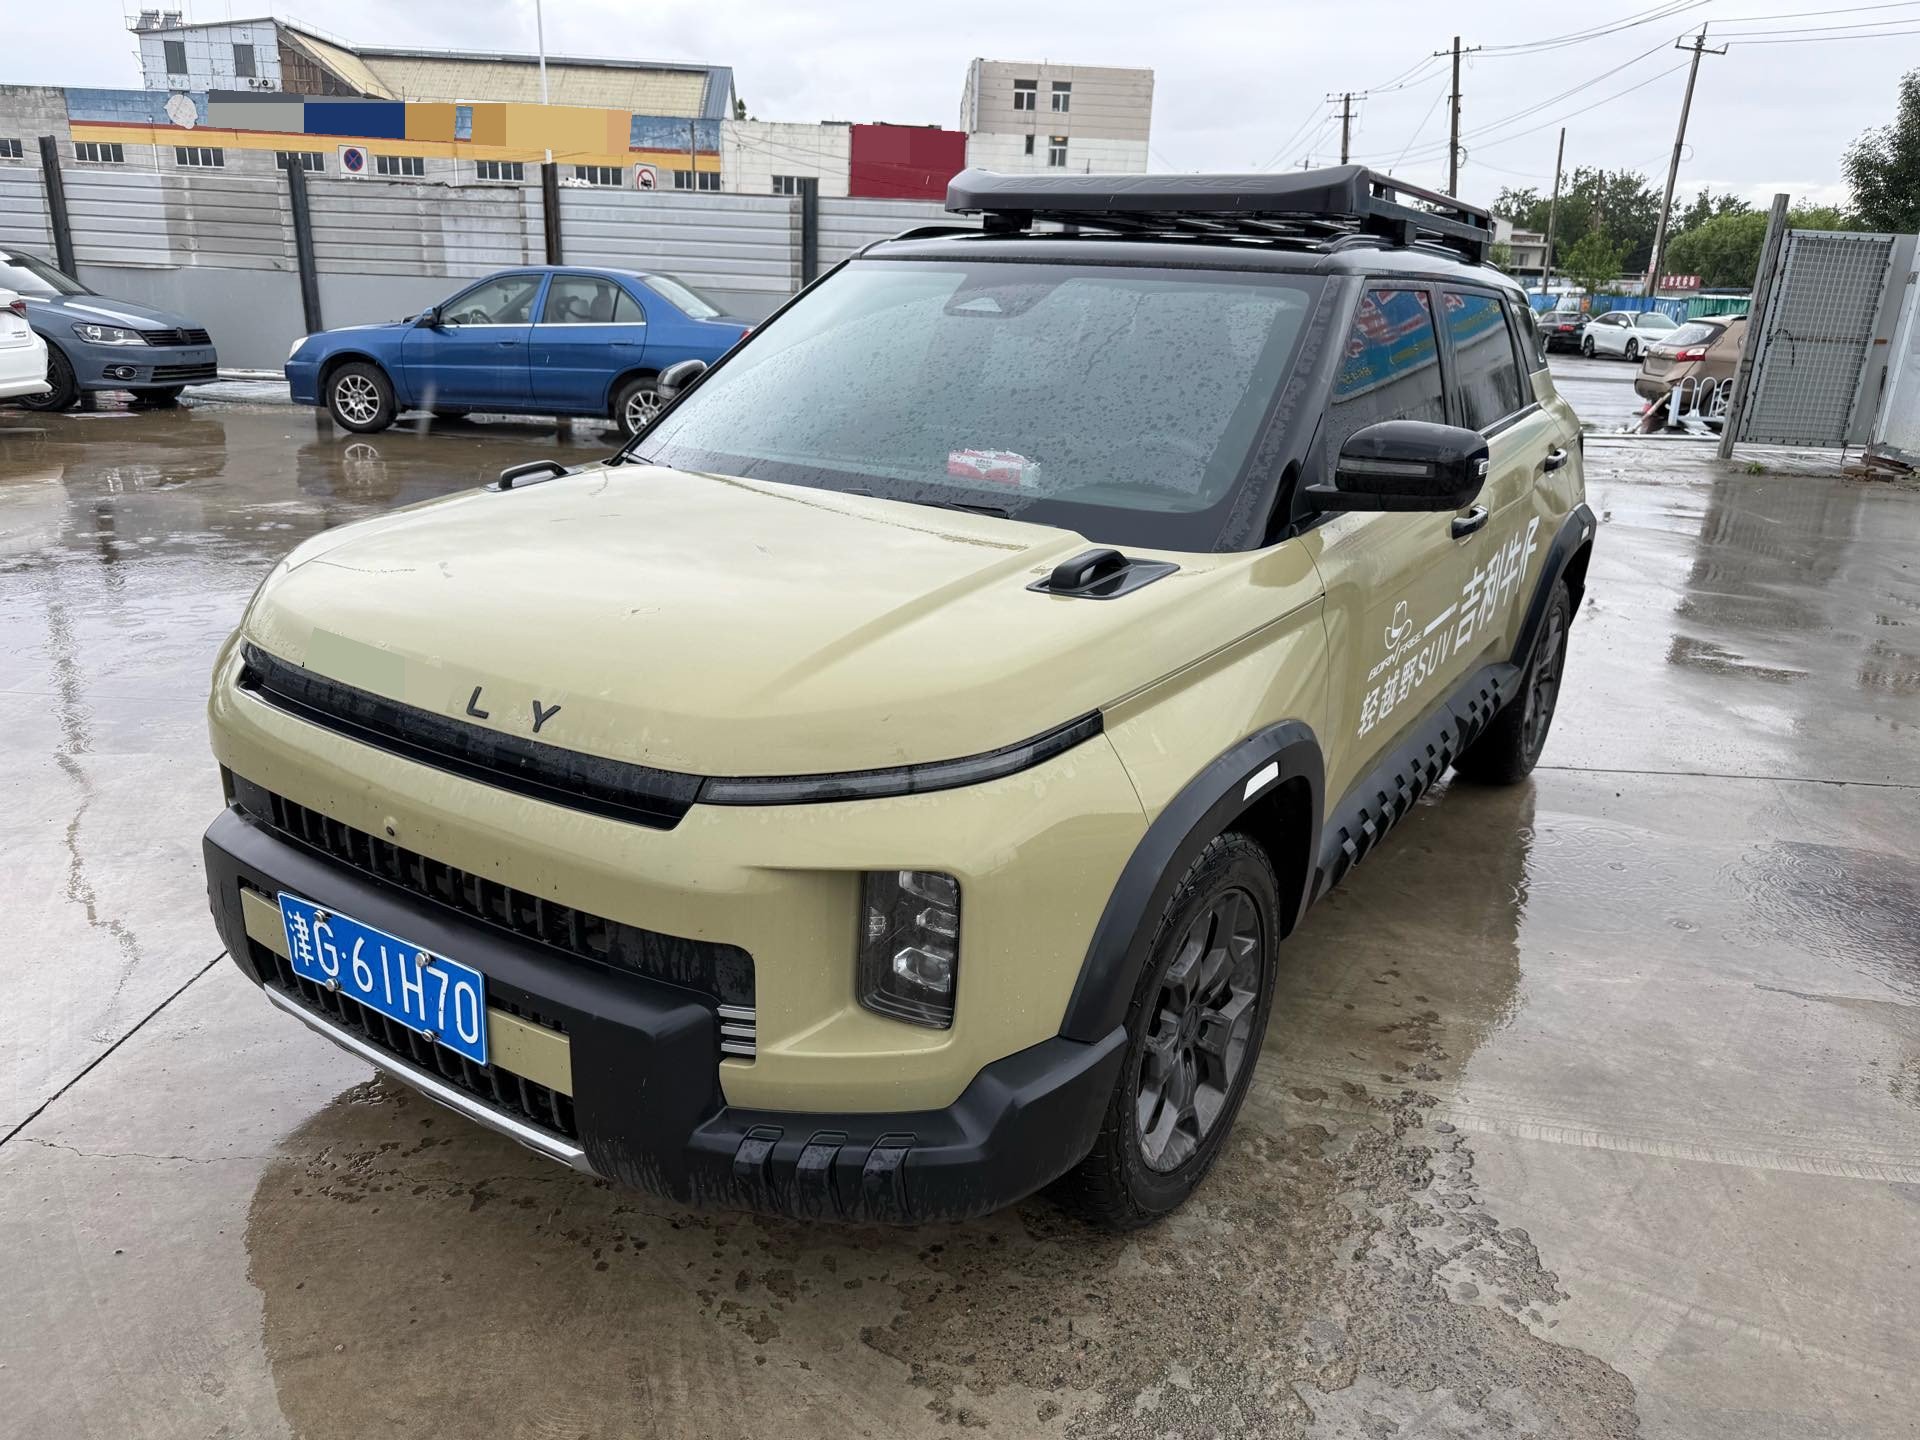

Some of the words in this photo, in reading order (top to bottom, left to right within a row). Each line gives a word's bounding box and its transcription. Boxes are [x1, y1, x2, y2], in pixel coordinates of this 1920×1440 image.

[1453, 515, 1540, 655] 吉利牛仔
[1367, 642, 1401, 682] BORN
[1394, 631, 1423, 666] FREE
